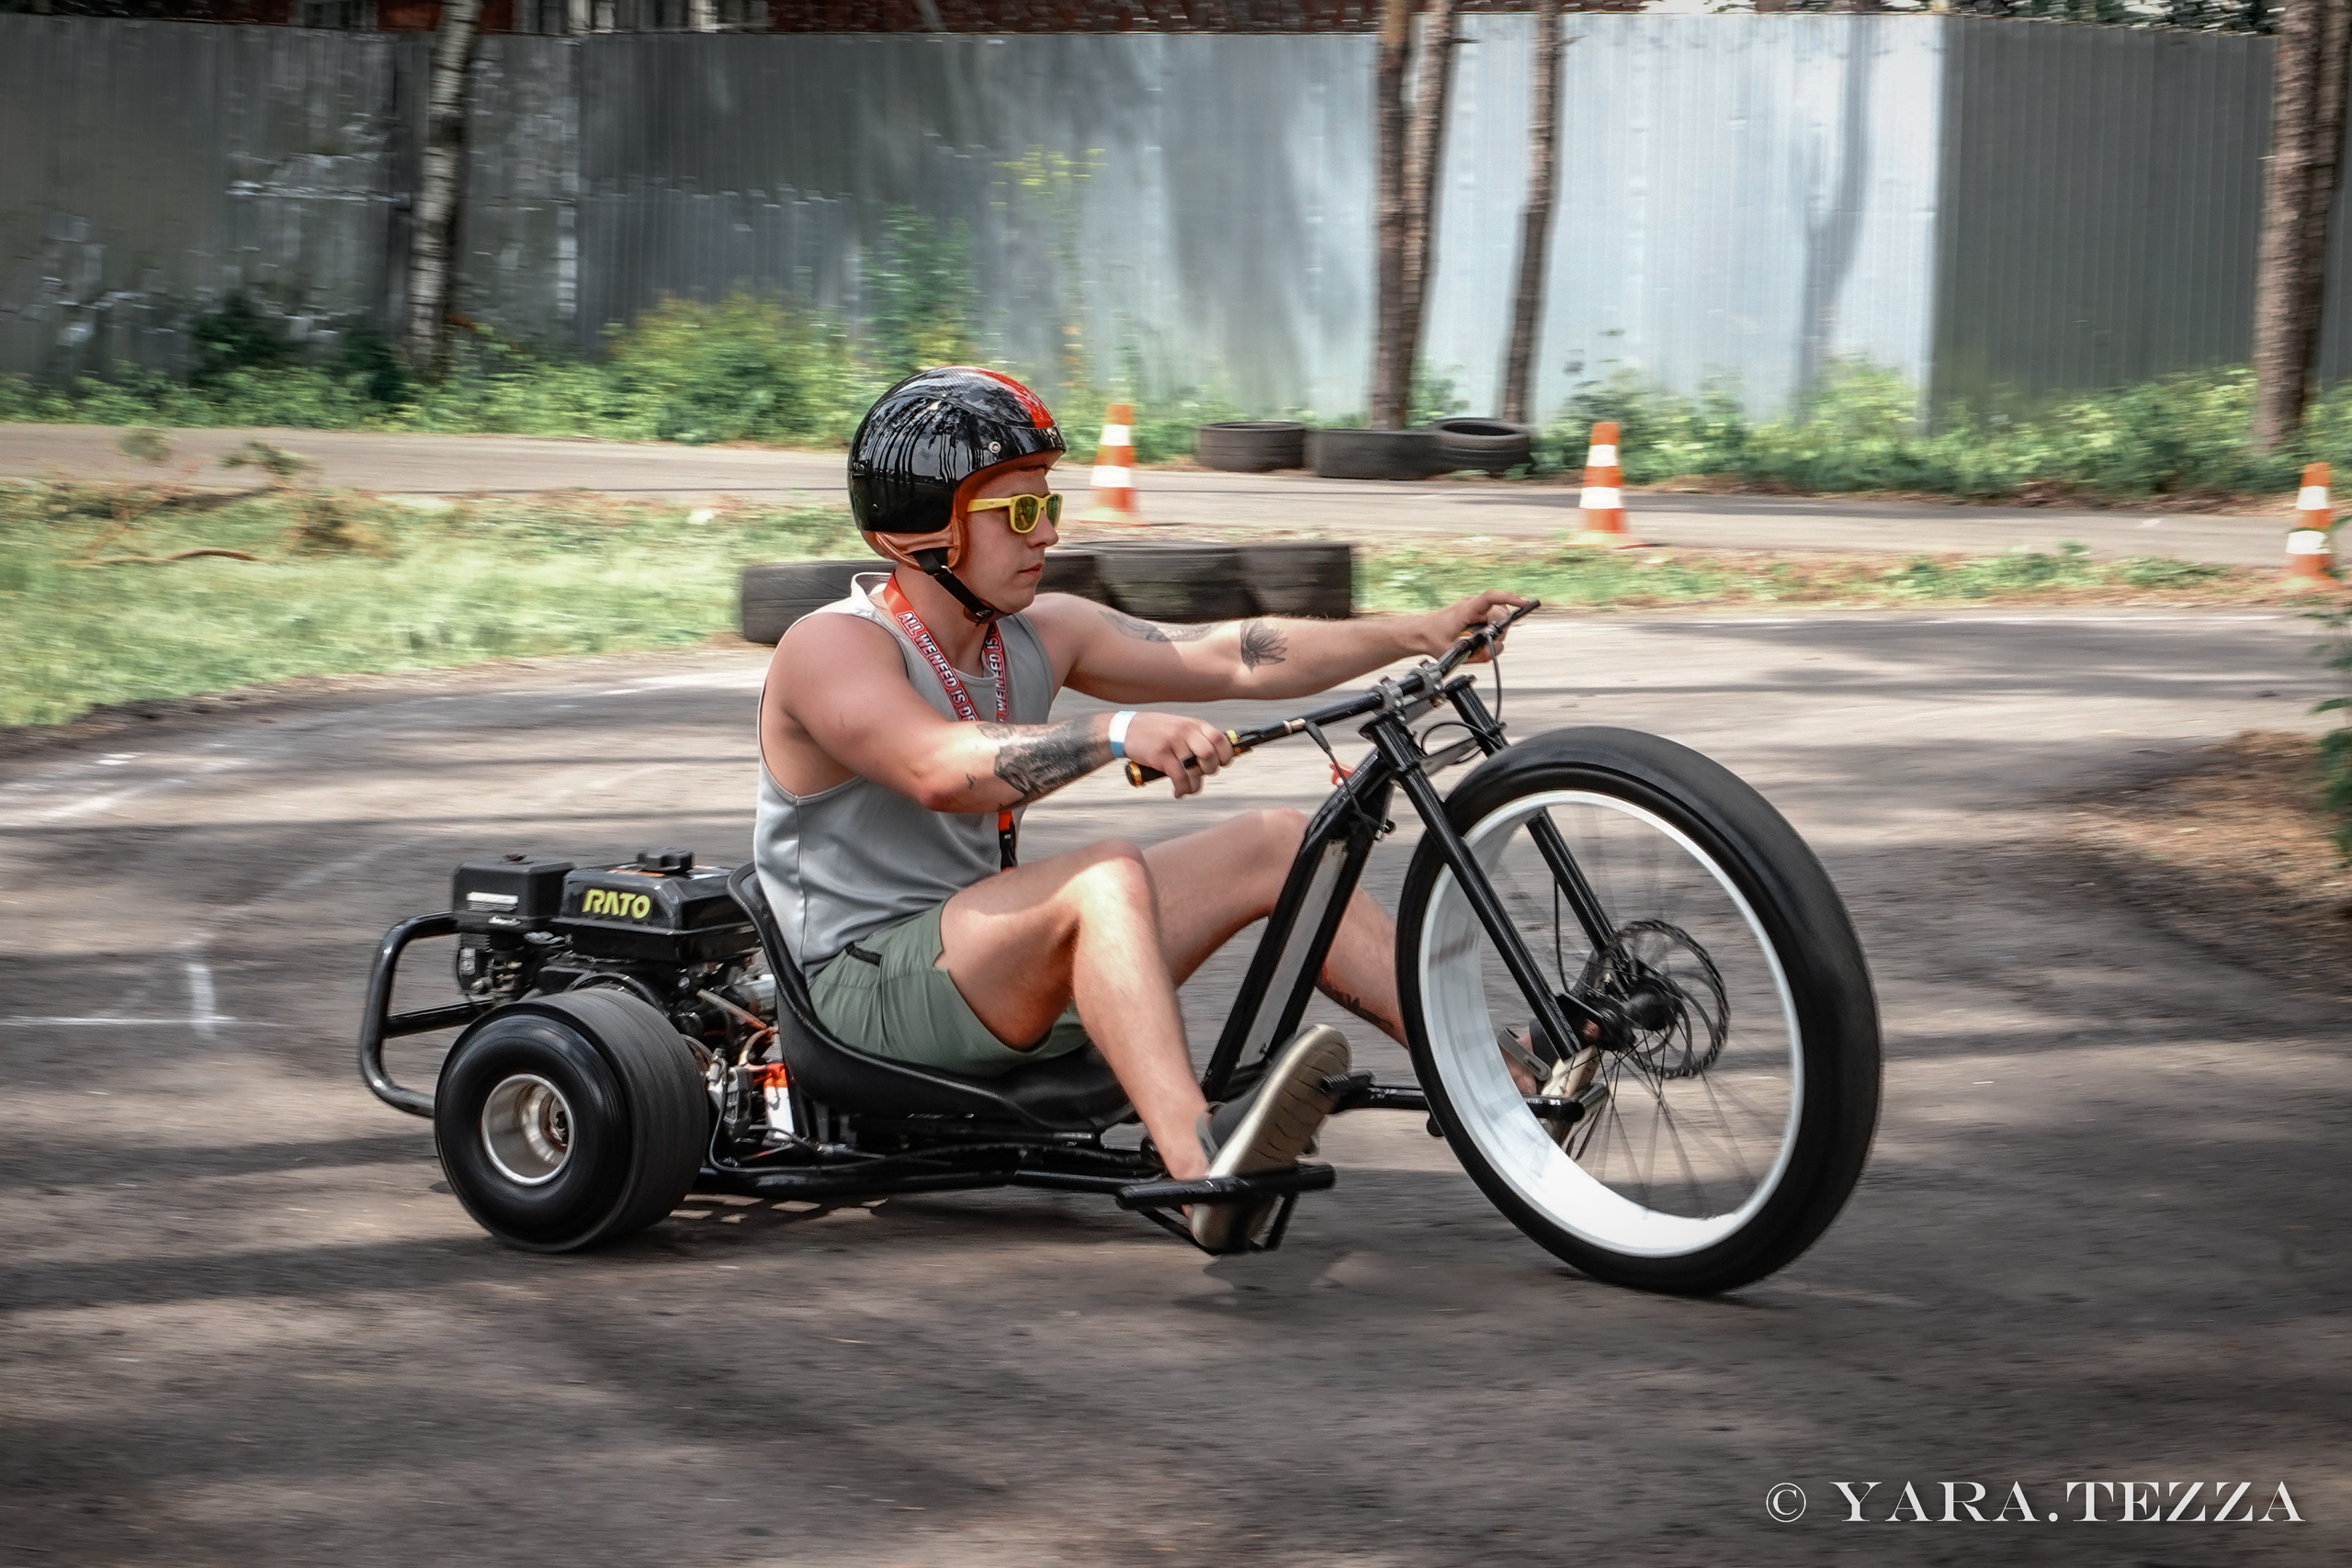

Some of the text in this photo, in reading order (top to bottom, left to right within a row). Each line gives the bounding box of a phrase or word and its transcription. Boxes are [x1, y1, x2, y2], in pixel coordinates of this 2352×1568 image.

[897, 611, 922, 637] ALL
[913, 631, 938, 656] WE
[927, 653, 958, 689] NEED
[947, 688, 967, 705] IS
[984, 635, 1002, 651] IS
[988, 652, 1007, 691] NEED
[582, 888, 651, 919] RATO
